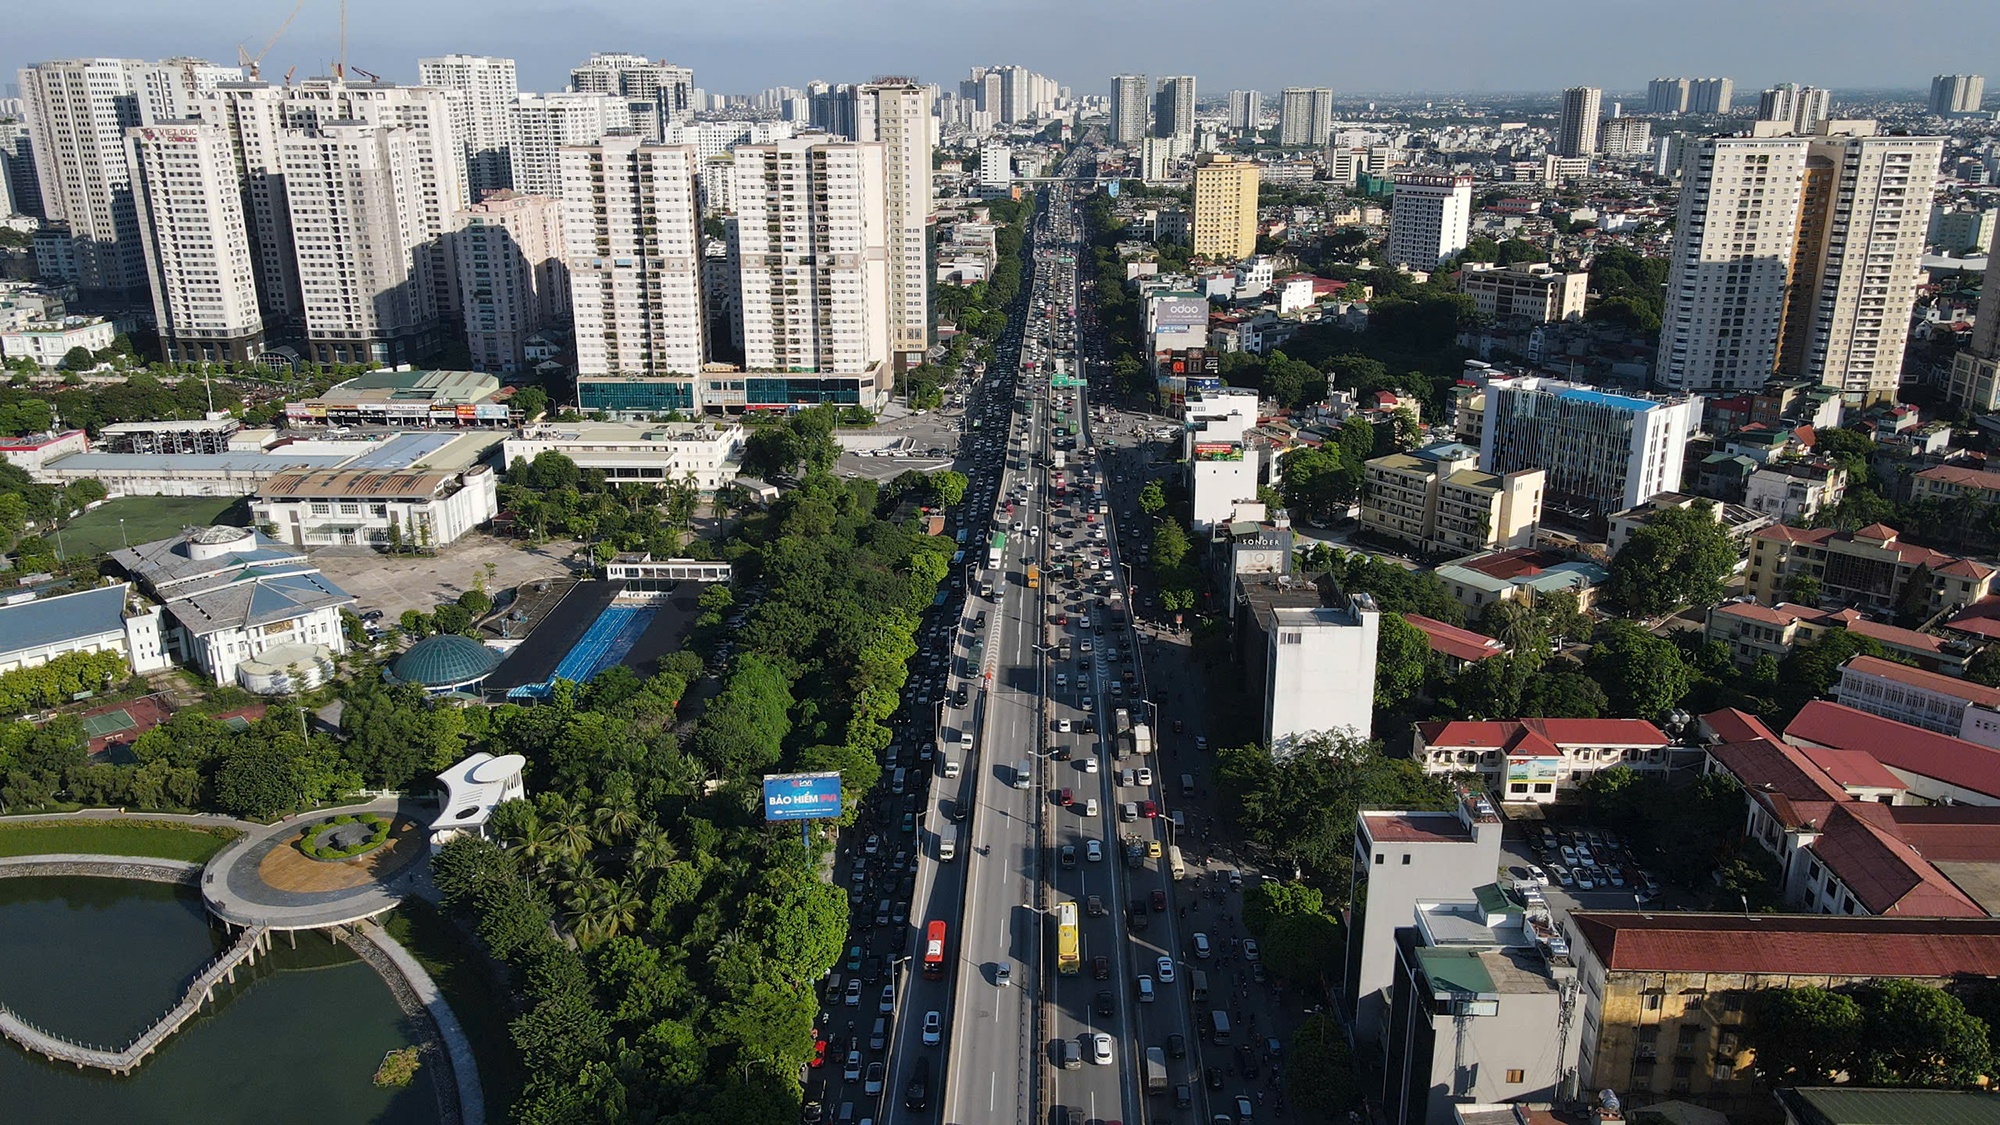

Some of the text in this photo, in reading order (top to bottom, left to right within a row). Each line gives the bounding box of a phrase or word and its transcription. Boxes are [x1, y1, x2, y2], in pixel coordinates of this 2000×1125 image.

[1170, 304, 1198, 314] odoo
[769, 791, 837, 805] BẢO HIỂM PVI
